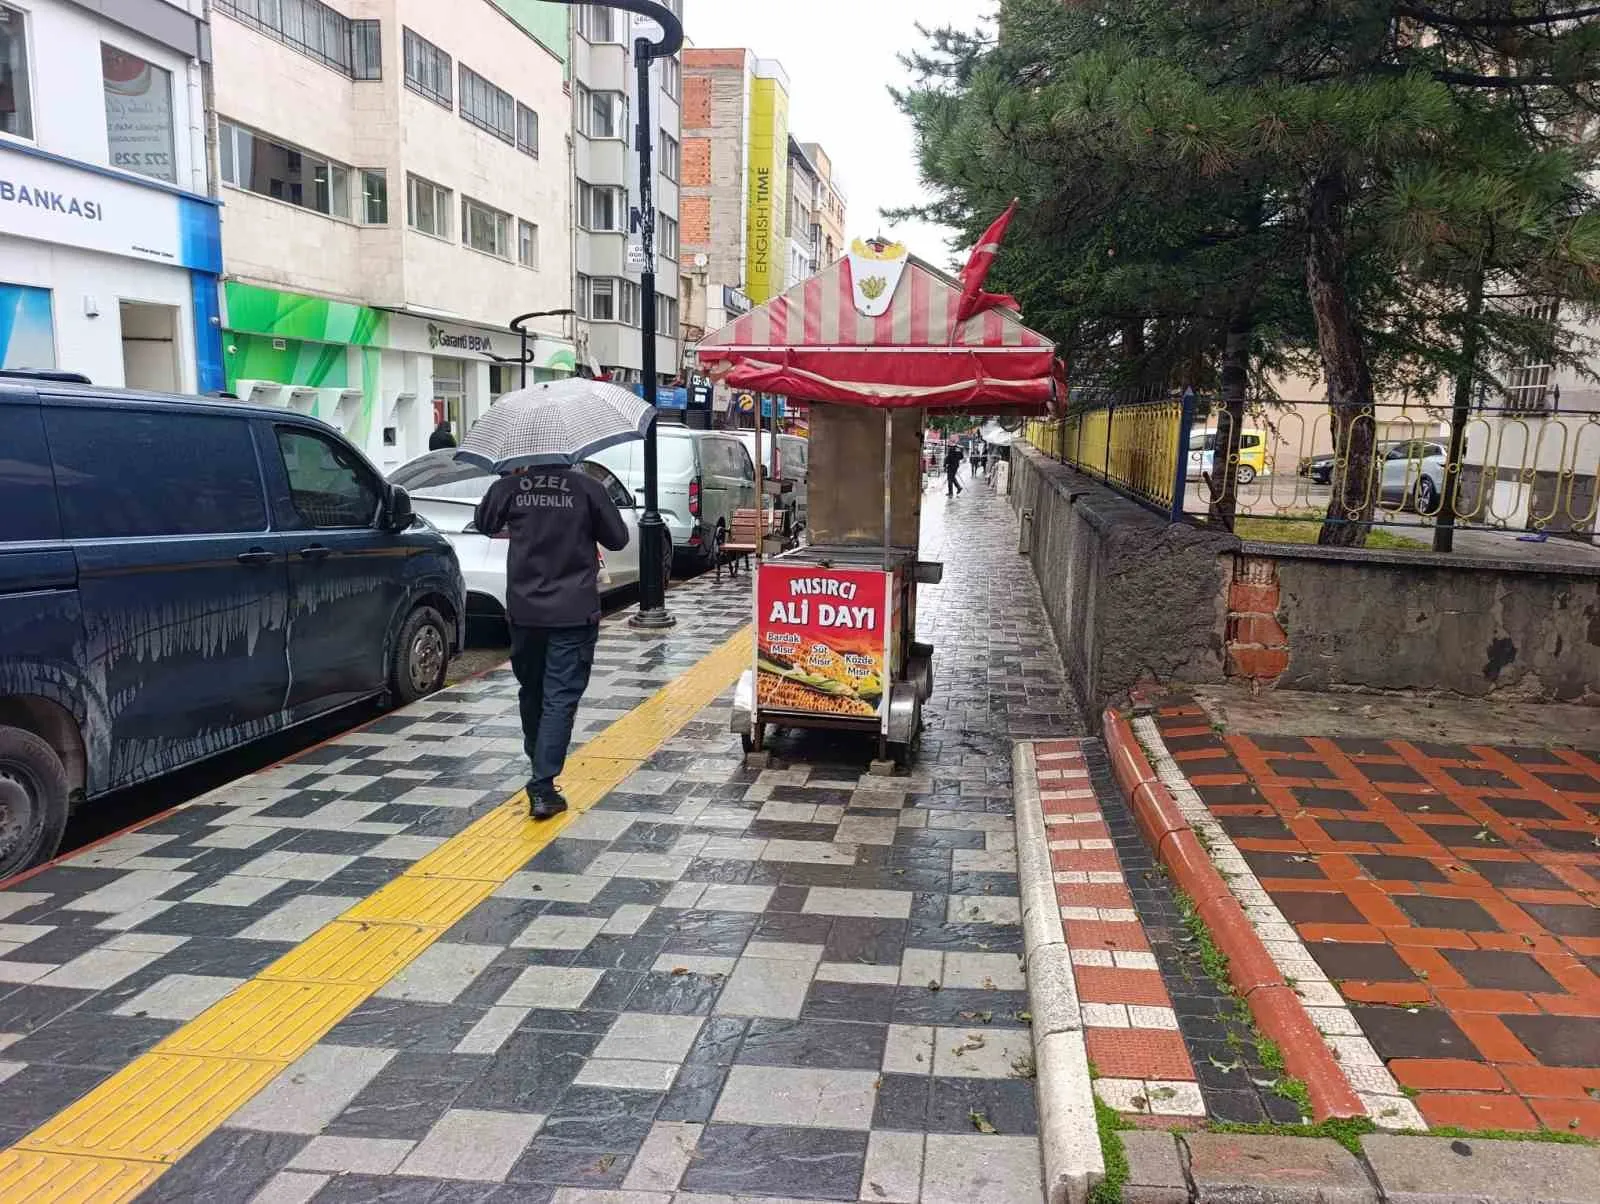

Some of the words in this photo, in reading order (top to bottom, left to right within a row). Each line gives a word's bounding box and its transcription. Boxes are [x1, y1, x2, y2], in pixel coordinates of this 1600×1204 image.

[757, 167, 770, 203] TIME
[0, 180, 102, 222] BANKASI
[756, 207, 769, 273] ENGLISH
[438, 329, 467, 350] Garanti
[468, 335, 493, 352] BBVA
[519, 475, 571, 493] ÖZEL
[515, 491, 574, 508] GÜVENLİK
[789, 577, 857, 601] MISIRCI
[769, 599, 809, 625] ALİ
[818, 603, 875, 630] DAYI
[767, 631, 801, 643] Bardak
[772, 645, 795, 655] Mısır
[812, 643, 828, 655] Süt
[808, 656, 832, 666] Mısır
[845, 654, 874, 665] Közde
[847, 667, 871, 677] Mısır
